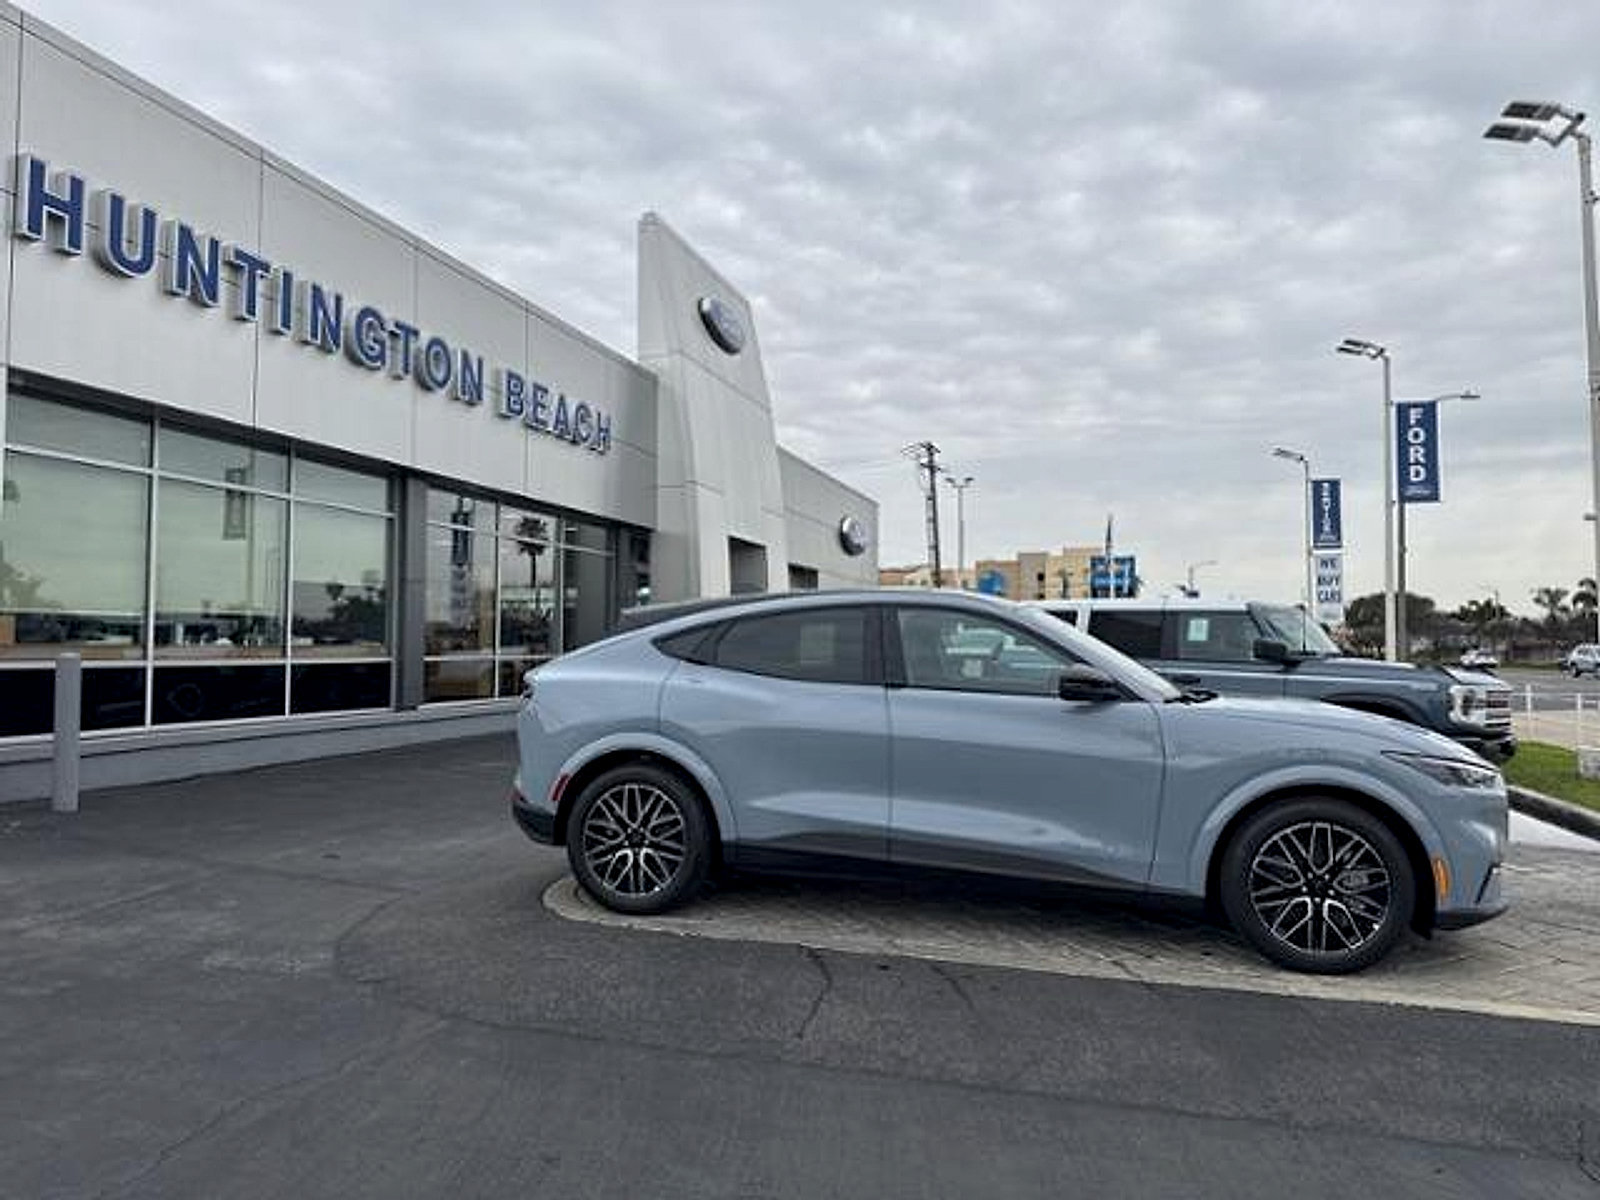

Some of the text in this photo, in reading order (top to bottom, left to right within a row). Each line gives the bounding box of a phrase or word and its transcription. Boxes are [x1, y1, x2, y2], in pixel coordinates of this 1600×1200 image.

[17, 154, 612, 455] HUNTINGTON BEACH
[1407, 407, 1427, 481] FORD
